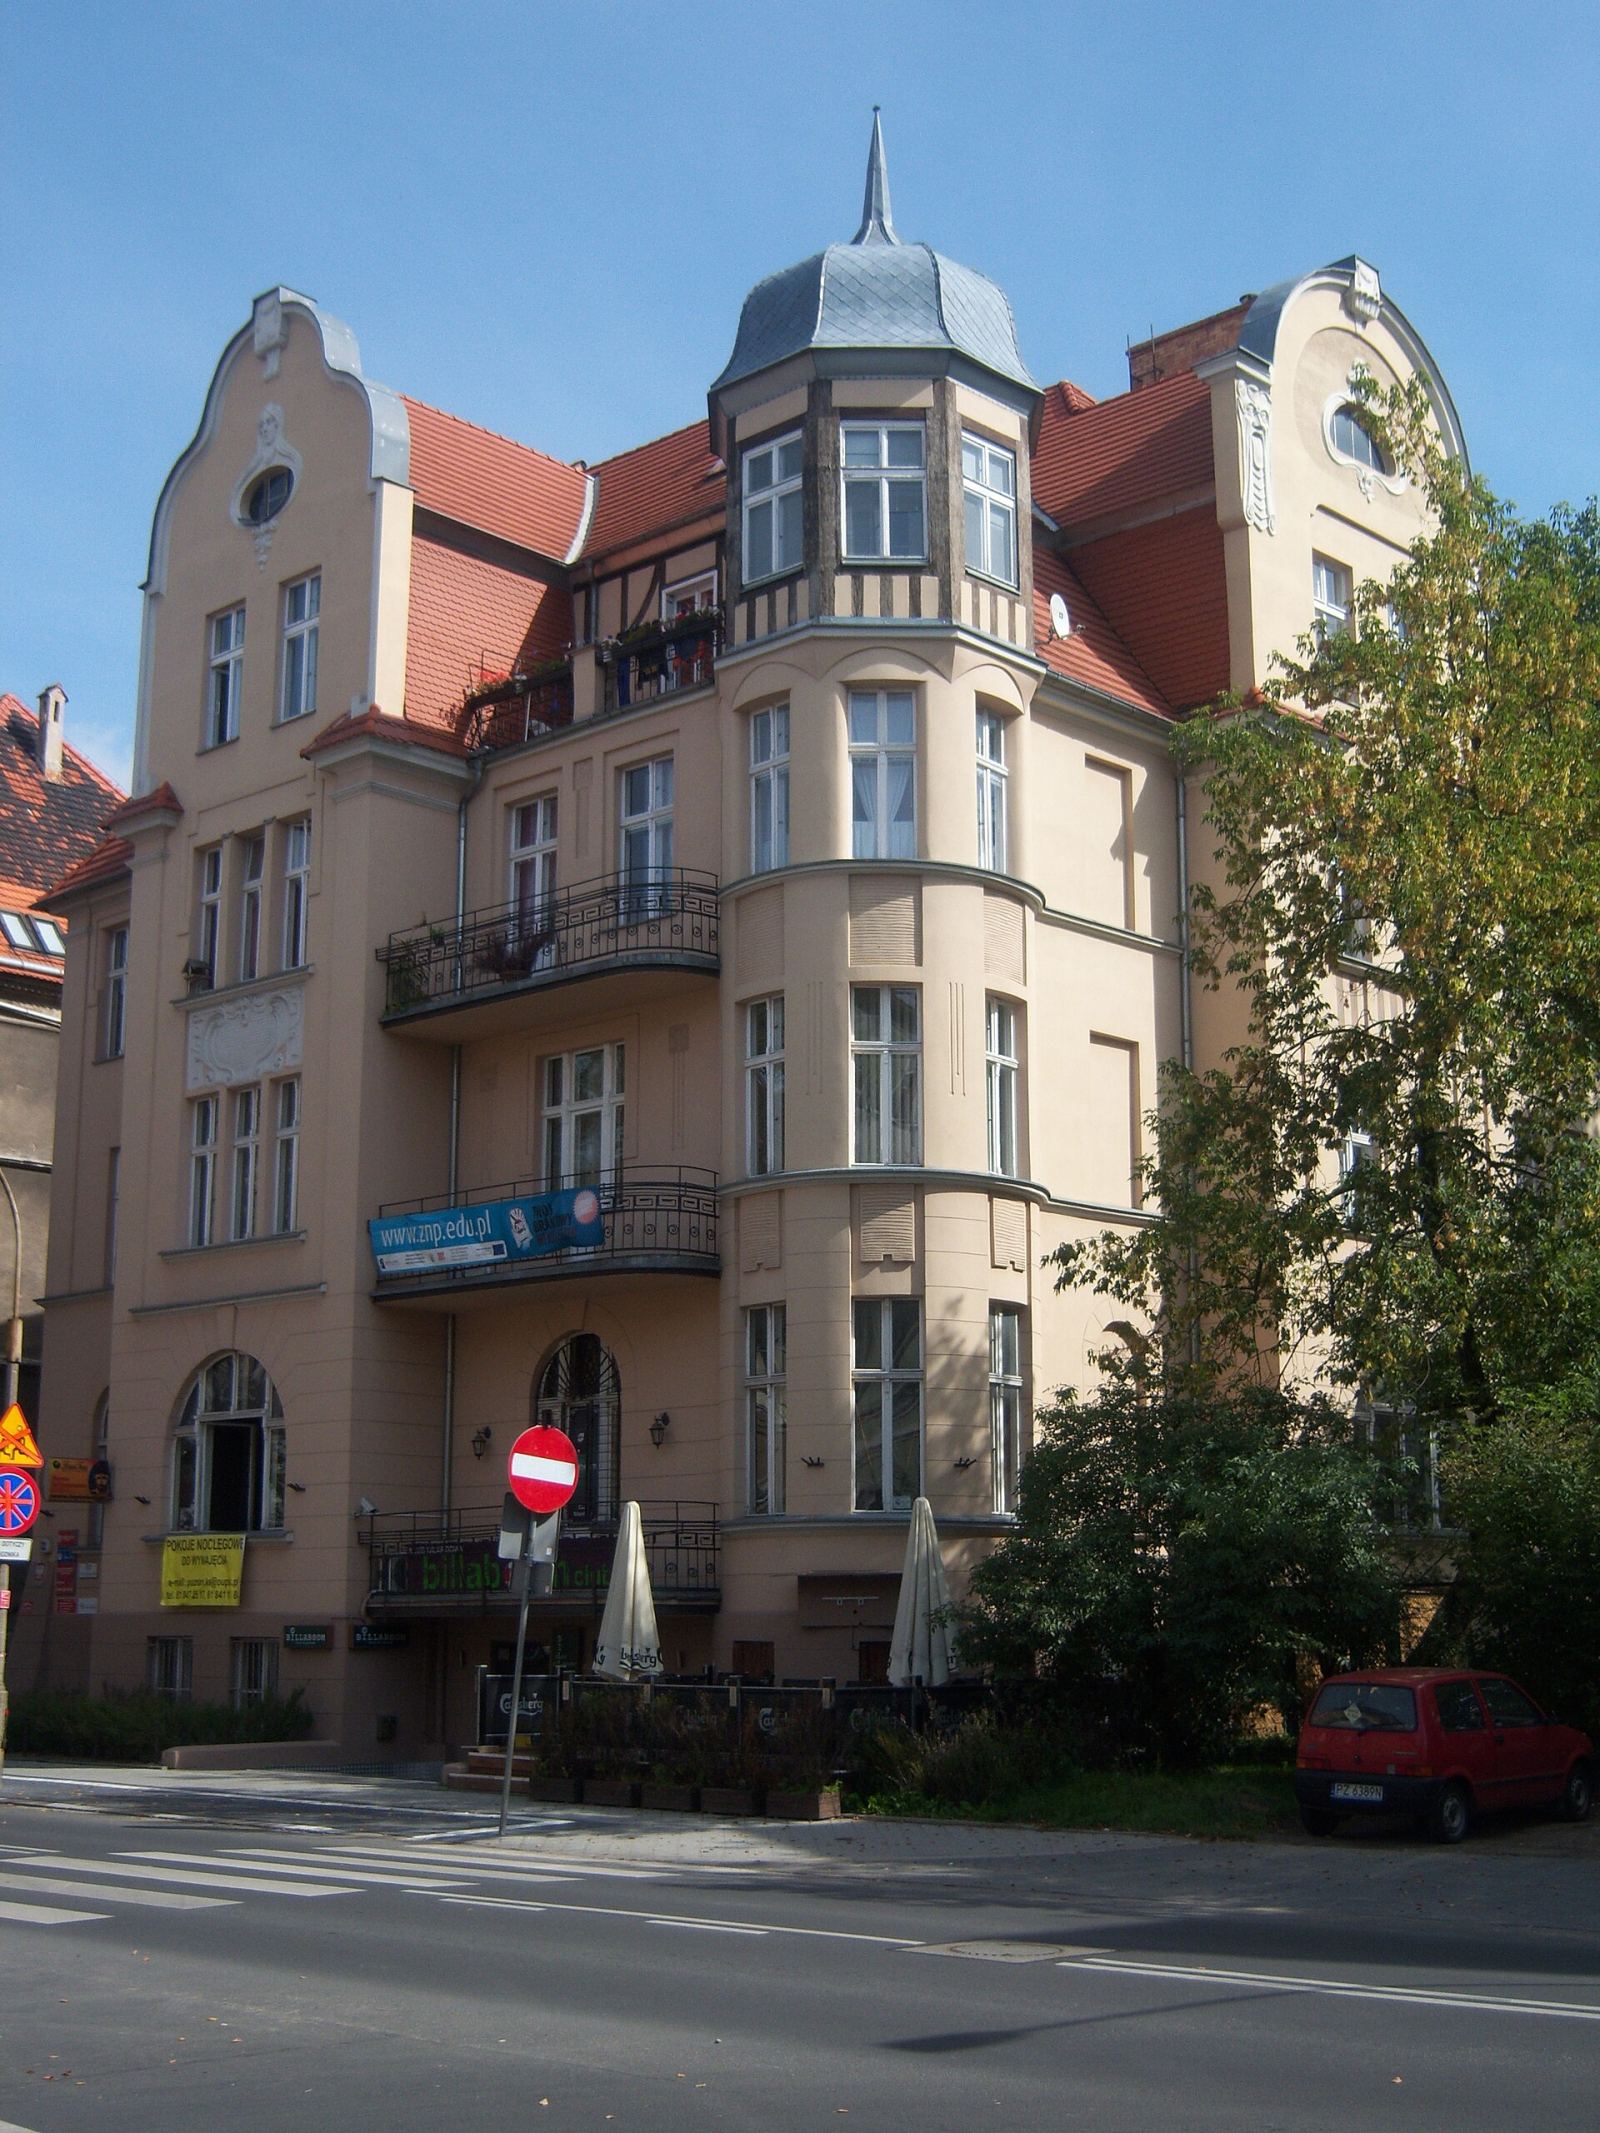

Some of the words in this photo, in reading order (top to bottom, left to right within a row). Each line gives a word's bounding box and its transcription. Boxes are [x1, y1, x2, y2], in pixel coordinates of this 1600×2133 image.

[381, 1209, 492, 1247] www.znp.edu.pl
[166, 1539, 195, 1551] POKOJE
[1337, 1784, 1350, 1796] PZ
[1352, 1785, 1382, 1799] 6389N
